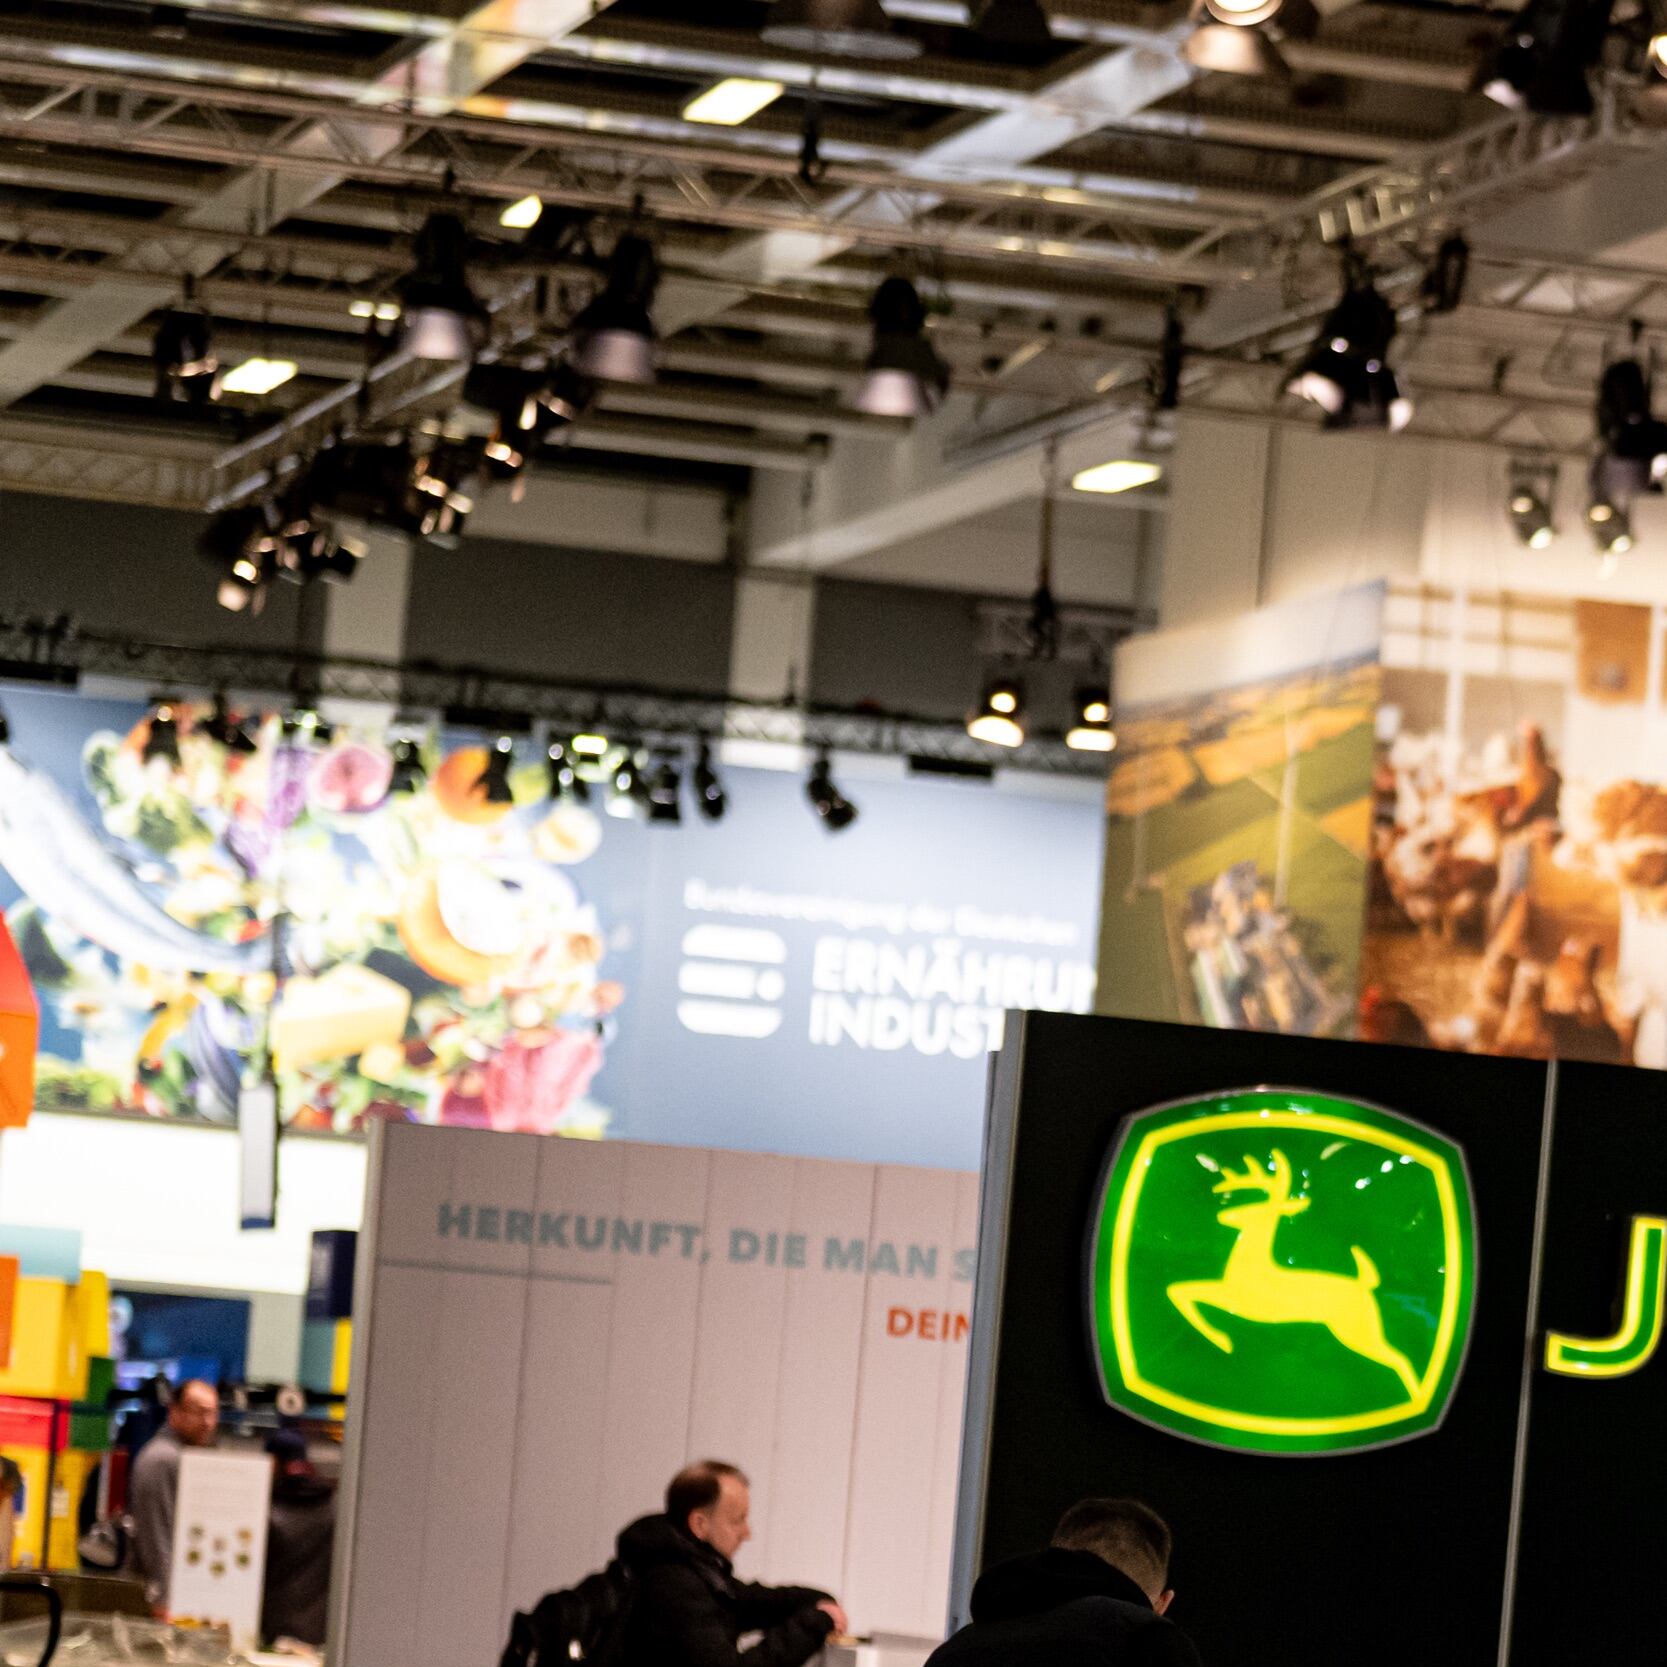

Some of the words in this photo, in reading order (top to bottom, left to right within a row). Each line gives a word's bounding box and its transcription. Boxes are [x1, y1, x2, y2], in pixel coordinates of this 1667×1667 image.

[436, 1203, 711, 1267] HERKUNFT,
[727, 1227, 808, 1270] DIE
[822, 1236, 938, 1280] MAN
